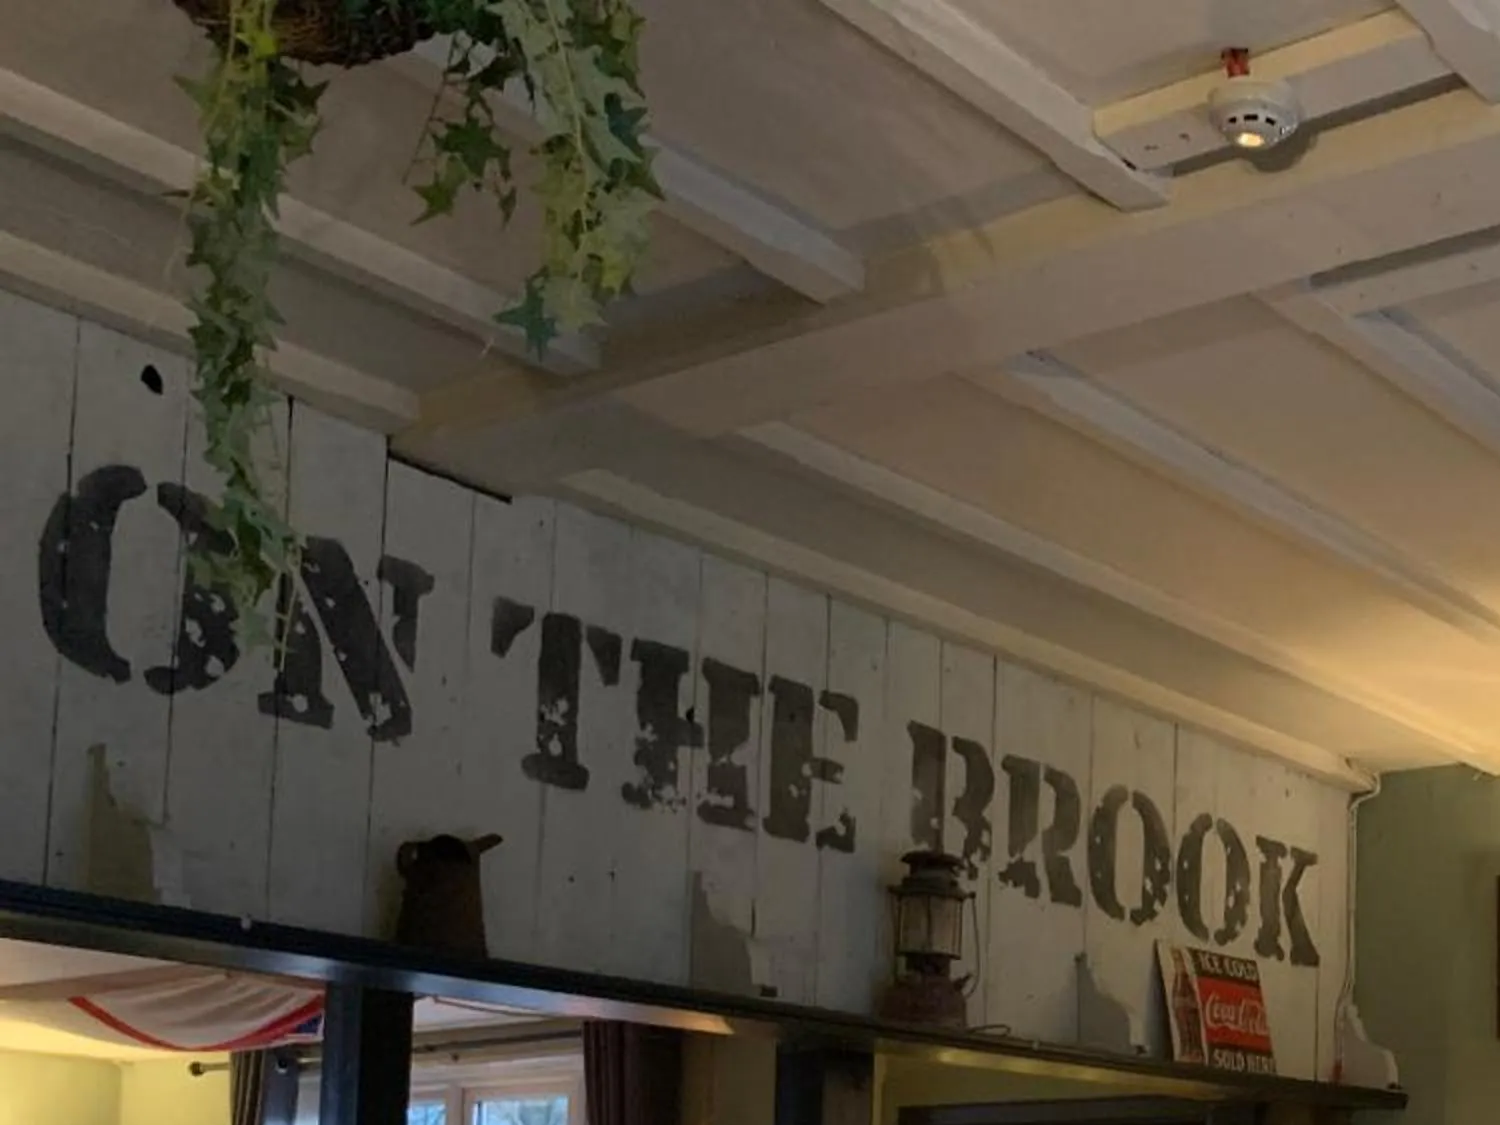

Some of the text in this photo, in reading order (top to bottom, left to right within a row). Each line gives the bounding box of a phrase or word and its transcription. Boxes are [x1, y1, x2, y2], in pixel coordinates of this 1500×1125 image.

[38, 464, 1320, 967] ON THE BROOK
[1197, 951, 1224, 975] ICE
[1213, 1048, 1245, 1073] SOLD
